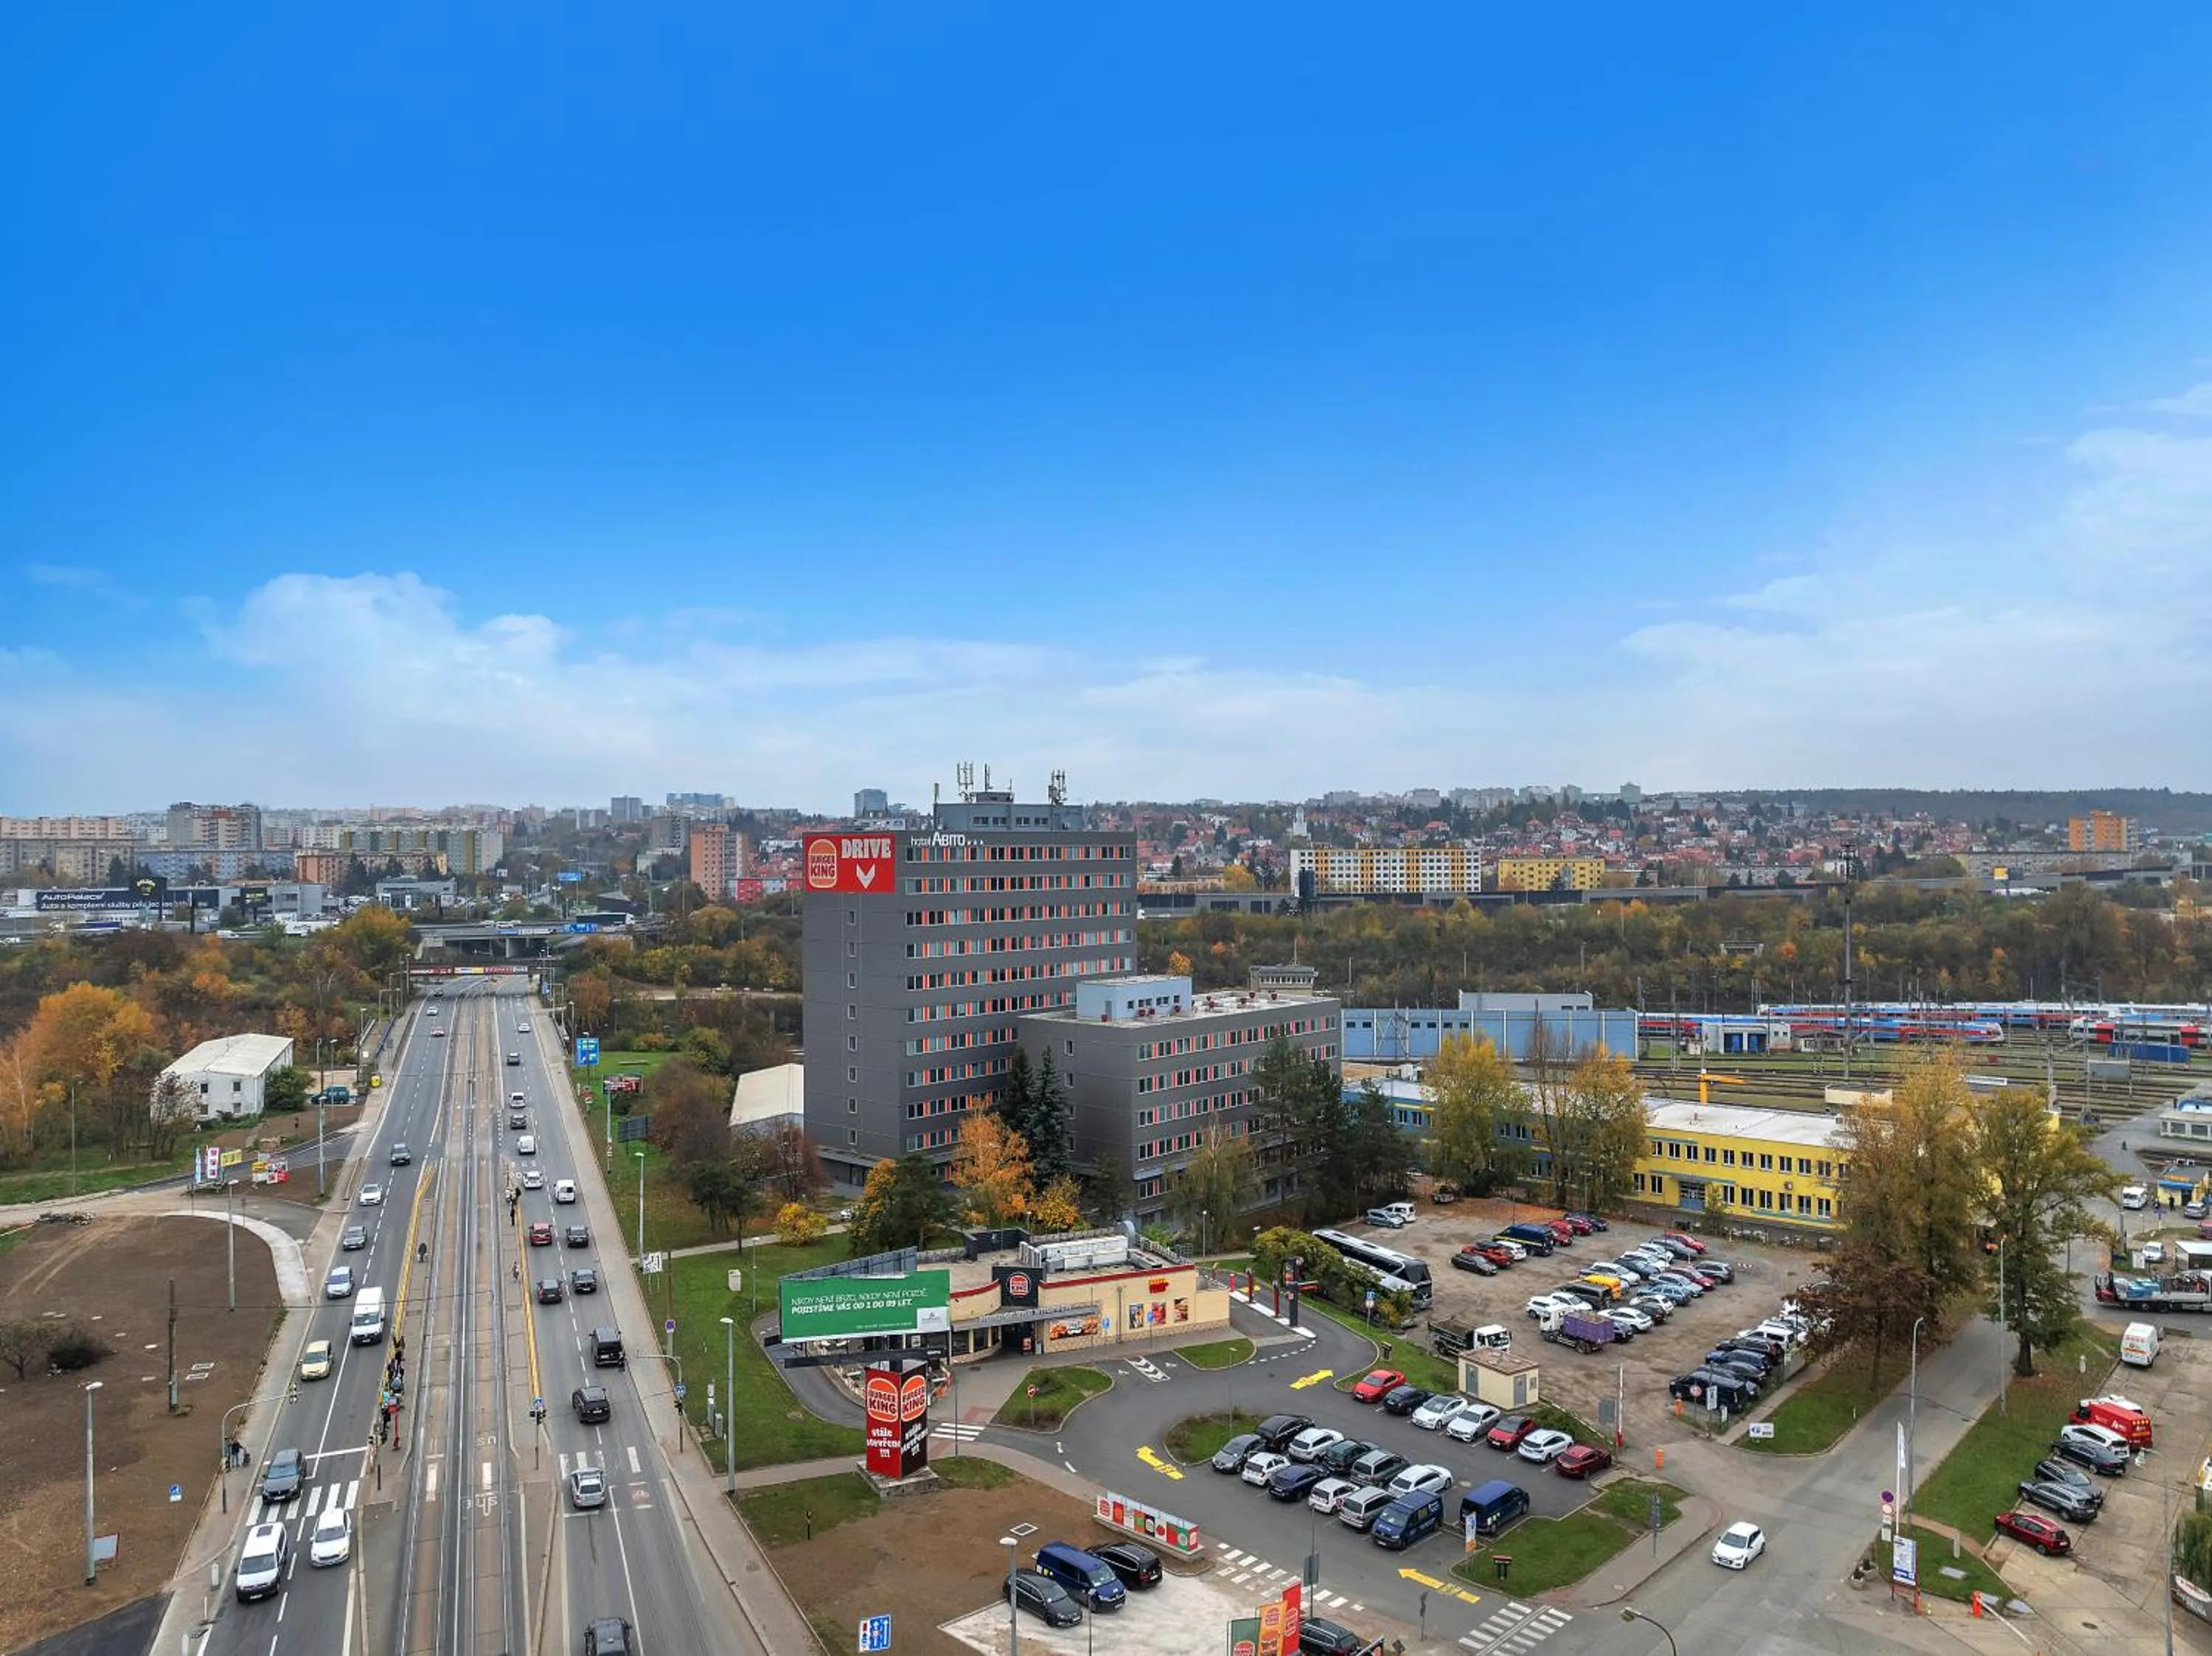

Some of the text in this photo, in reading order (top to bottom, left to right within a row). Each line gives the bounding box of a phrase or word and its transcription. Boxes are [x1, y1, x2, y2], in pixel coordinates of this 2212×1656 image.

[841, 838, 891, 859] DRIVE
[811, 863, 835, 877] KING
[791, 1297, 814, 1306] NIKDY
[869, 1391, 895, 1402] BURGER
[869, 1397, 897, 1414] KING
[902, 1395, 925, 1414] KING
